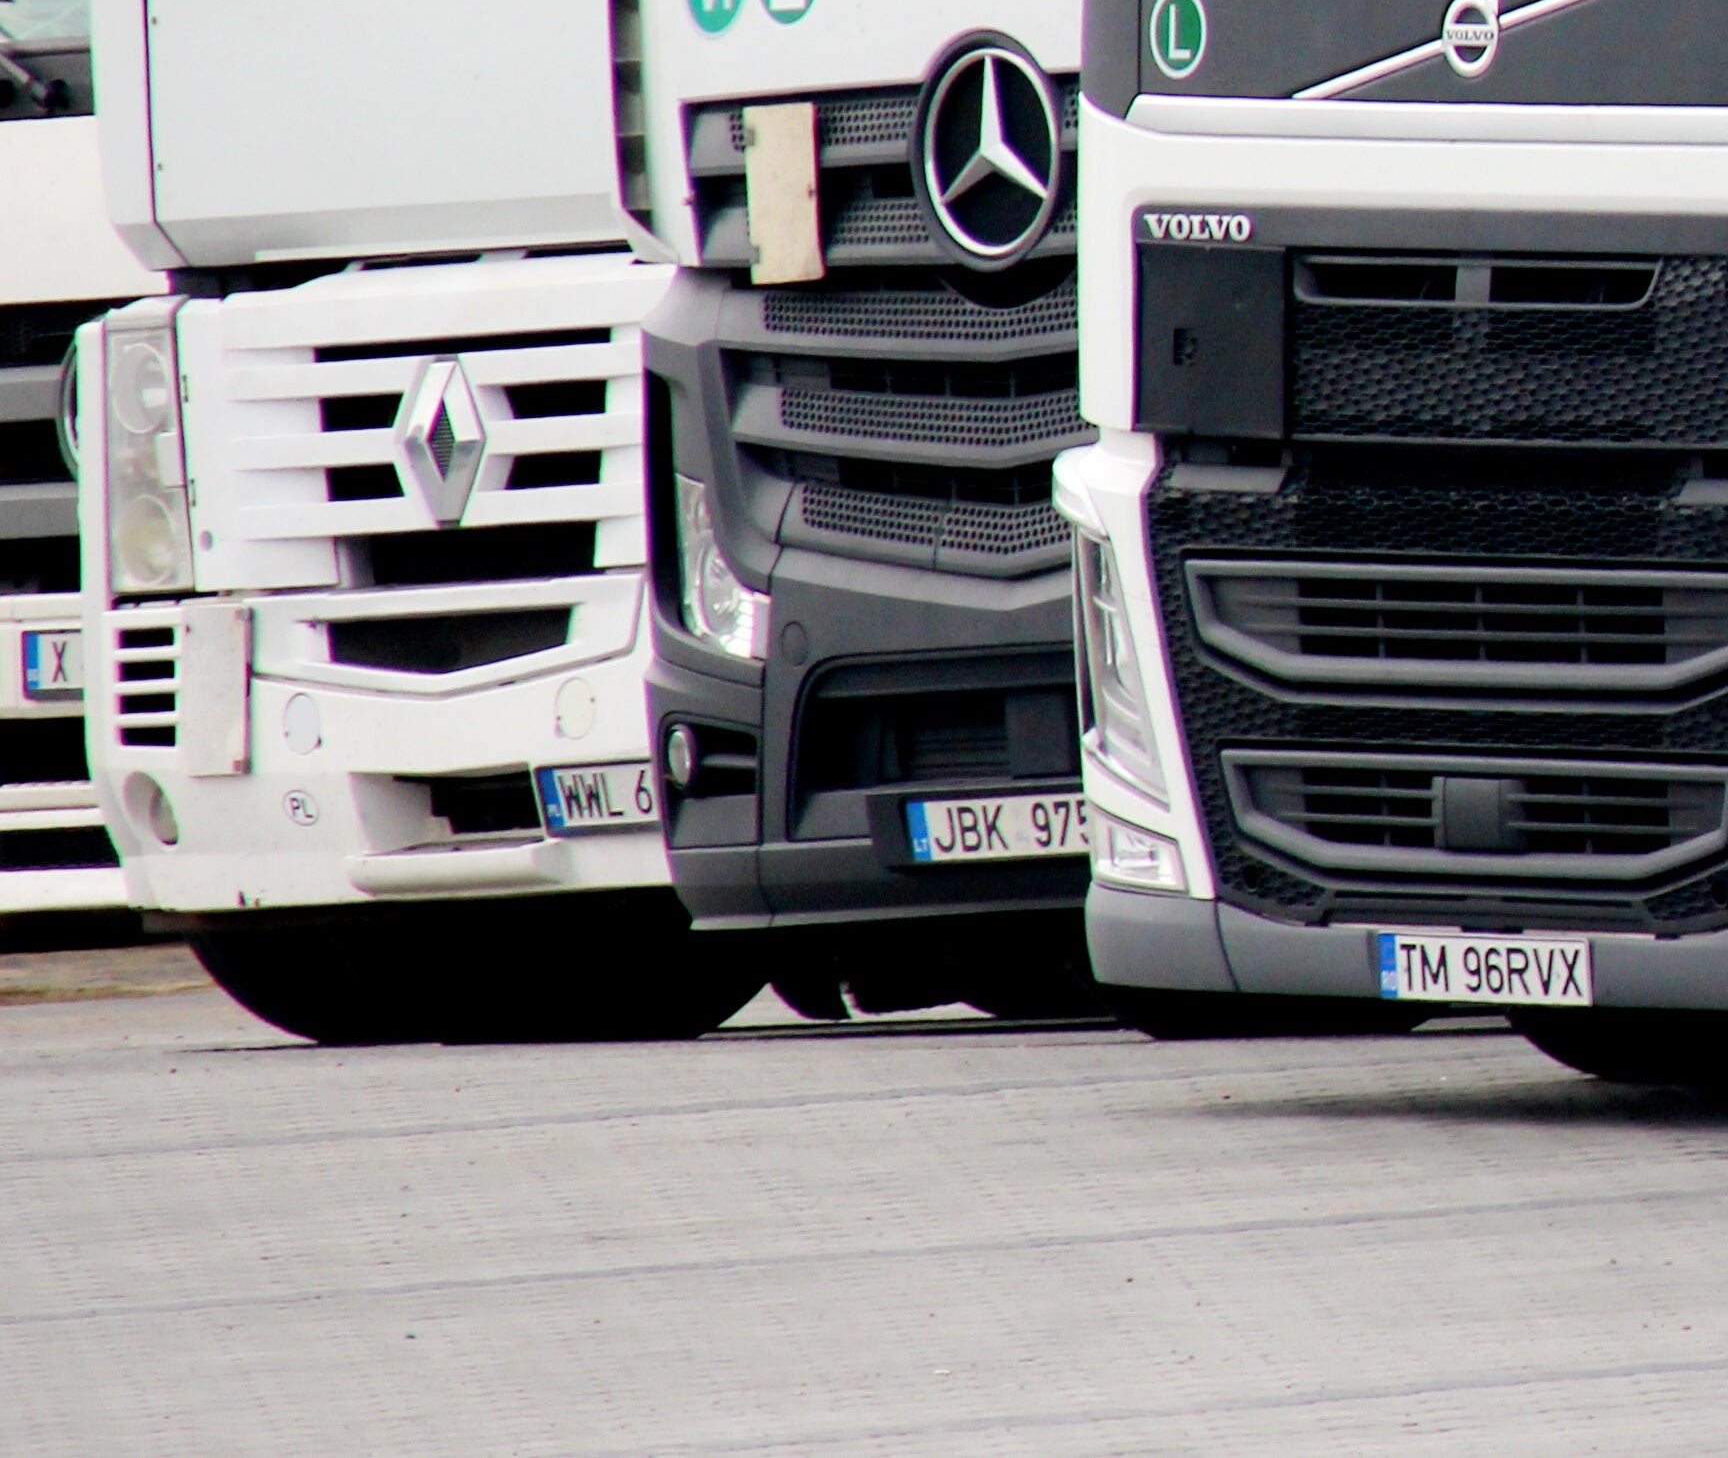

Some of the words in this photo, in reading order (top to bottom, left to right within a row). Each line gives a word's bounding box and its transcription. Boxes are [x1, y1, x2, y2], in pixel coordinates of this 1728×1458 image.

[1167, 4, 1191, 59] L
[1446, 29, 1494, 41] VOLVO
[1143, 214, 1252, 242] VOLVO
[290, 797, 314, 818] PL
[557, 772, 624, 820] WWL
[634, 769, 653, 814] 6
[934, 804, 1008, 852] JBK
[1399, 944, 1449, 992] TM
[1464, 946, 1583, 996] 96RVX
